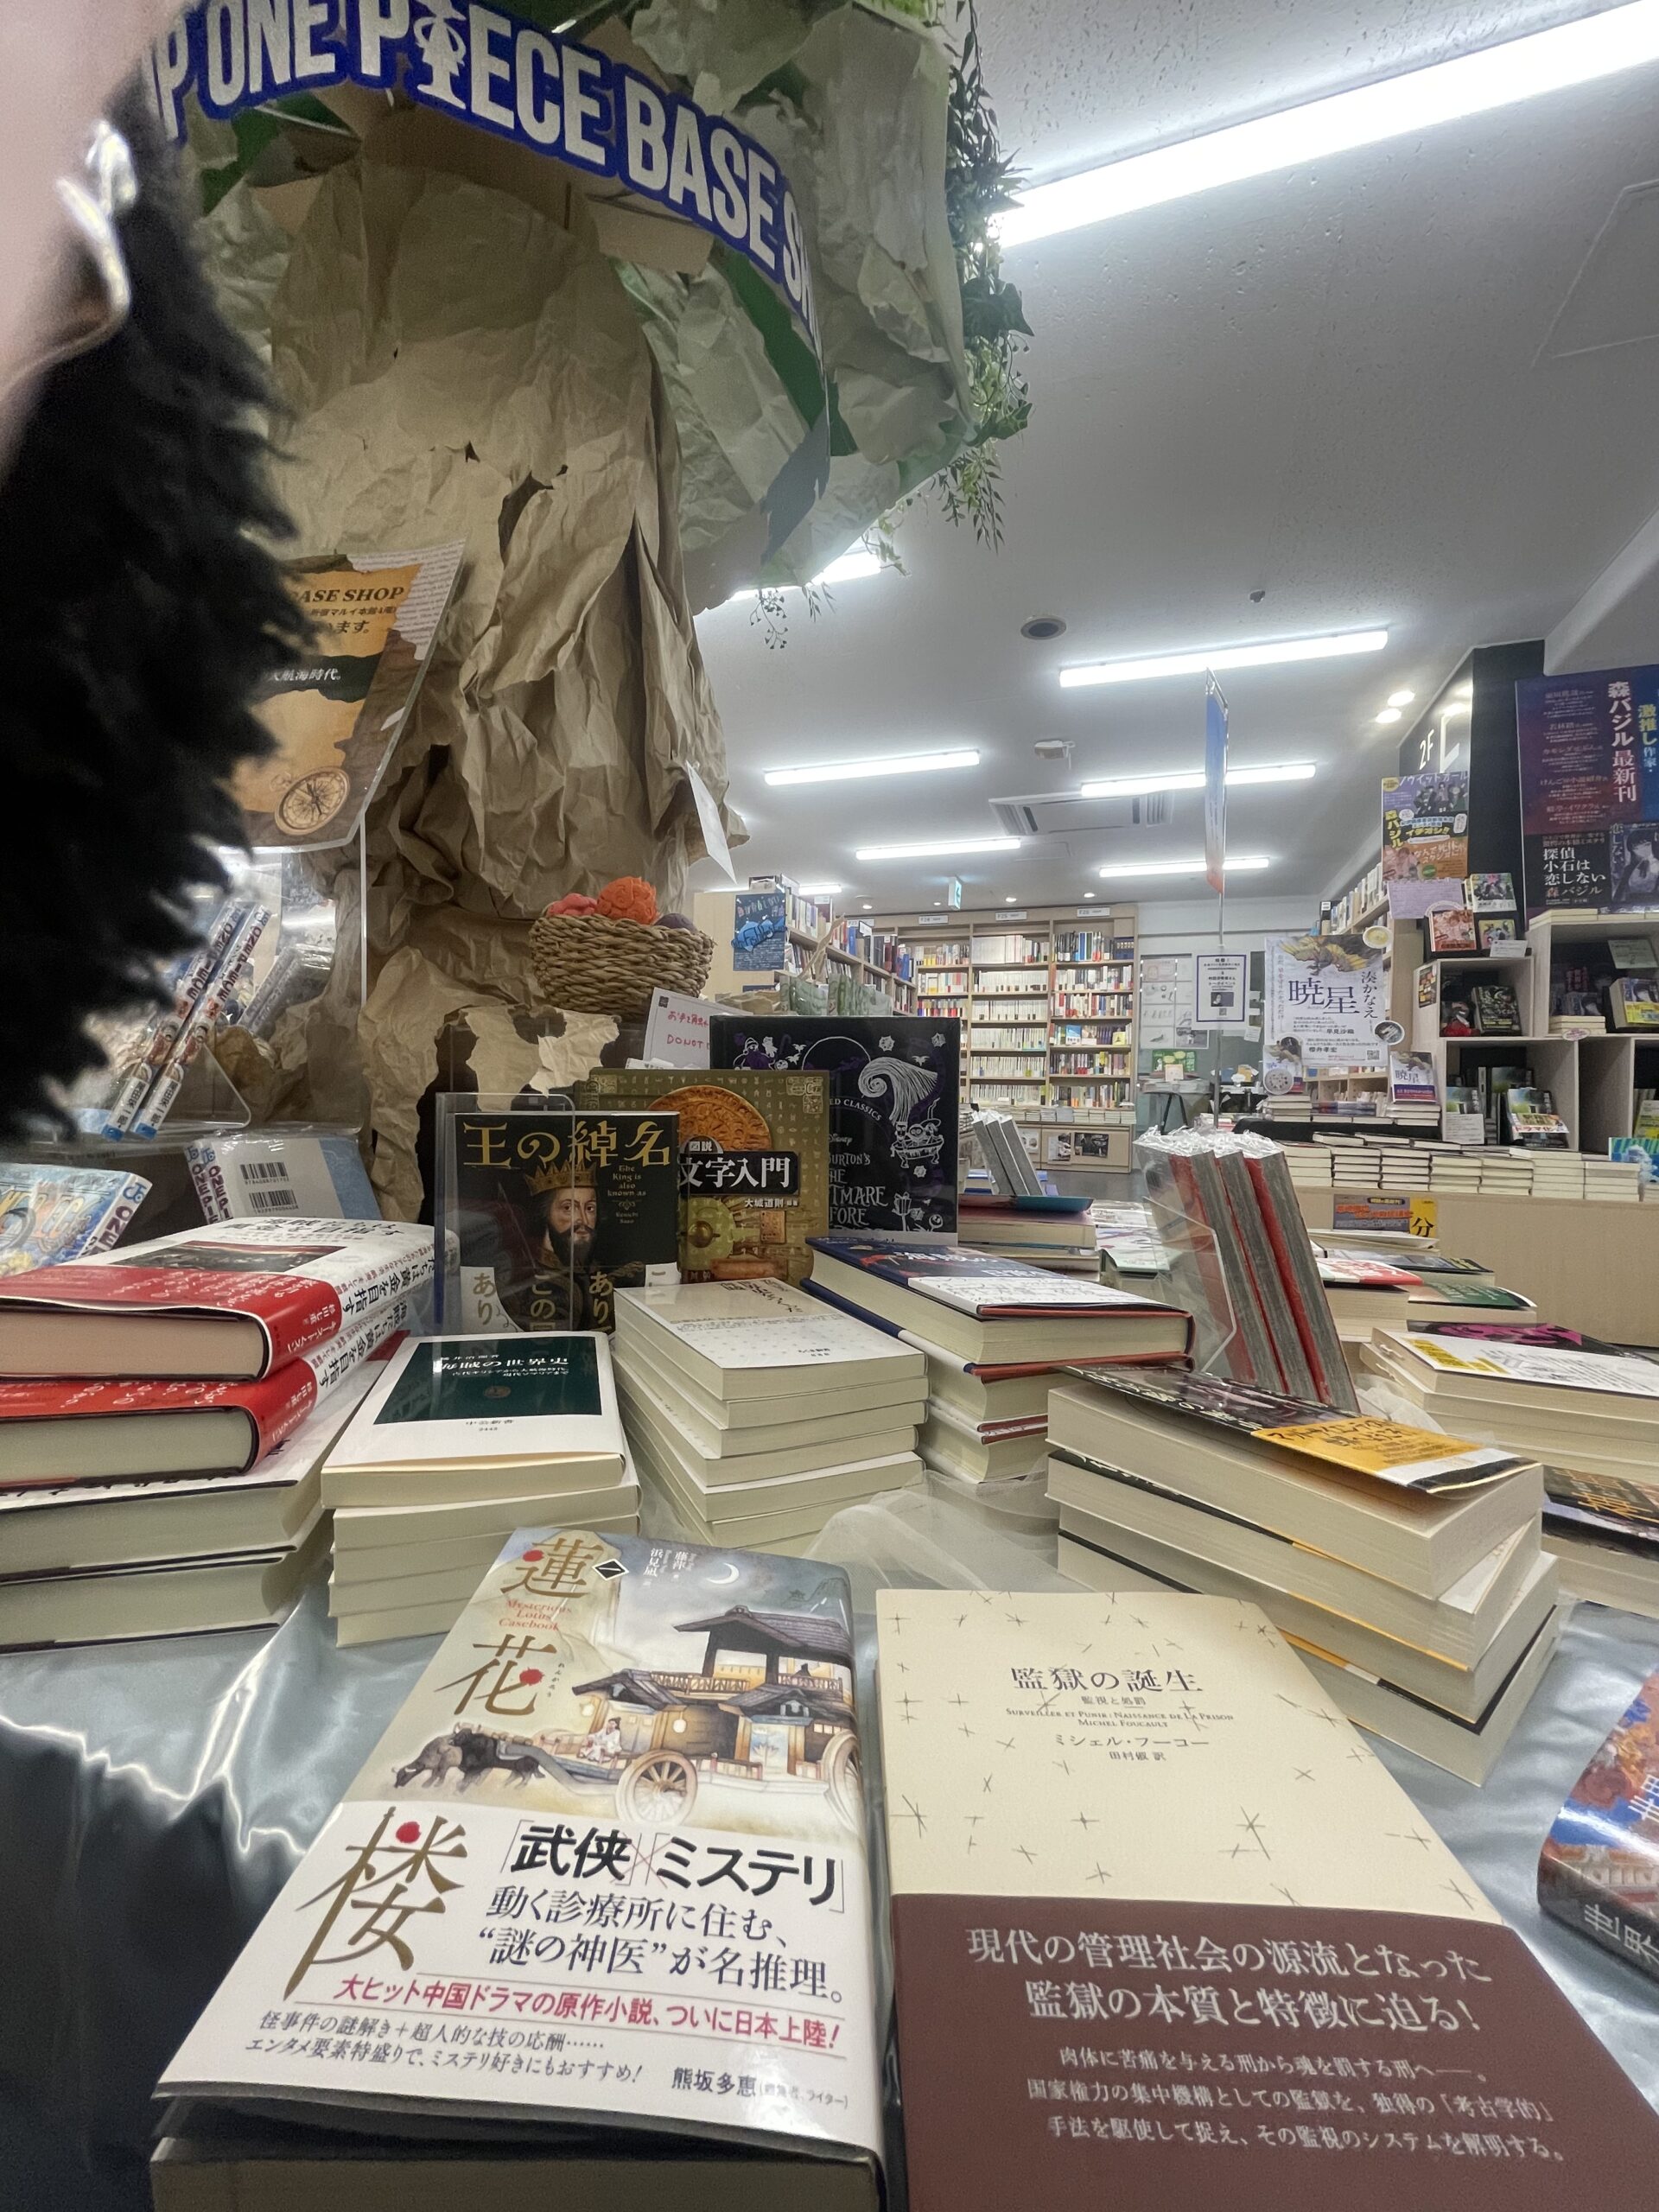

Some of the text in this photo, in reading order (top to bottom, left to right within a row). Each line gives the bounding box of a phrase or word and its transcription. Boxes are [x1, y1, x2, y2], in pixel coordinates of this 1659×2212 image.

[206, 0, 337, 107] ONE
[625, 79, 779, 264] BASE
[342, 587, 404, 602] SHOP
[1543, 847, 1576, 861] 探偵
[1543, 860, 1591, 873] 小石は
[1544, 873, 1606, 886] 恋しない
[1287, 977, 1360, 1014] 暁星
[843, 1098, 882, 1122] CLASSICS
[461, 1120, 671, 1168] 王の綽名
[613, 1173, 632, 1182] King
[530, 1274, 556, 1331] この
[500, 1537, 604, 1599] 蓮
[505, 1599, 572, 1613] Mysterious
[516, 1611, 551, 1621] Lotus
[499, 1618, 558, 1631] Casebook
[448, 1633, 558, 1716] 花
[1010, 1667, 1204, 1693] 監獄の誕生
[1077, 1718, 1168, 1728] MICHEL FOUCAULT
[1055, 1734, 1210, 1748] ミシェル・フーコー
[486, 1885, 789, 1948] 動く診療所に住む、
[965, 1927, 1493, 1983] 現代の管理社会の源流となった
[1024, 1979, 1482, 2033] 監獄の本質と特徴に迫る！
[672, 2065, 757, 2097] 熊坂多恵
